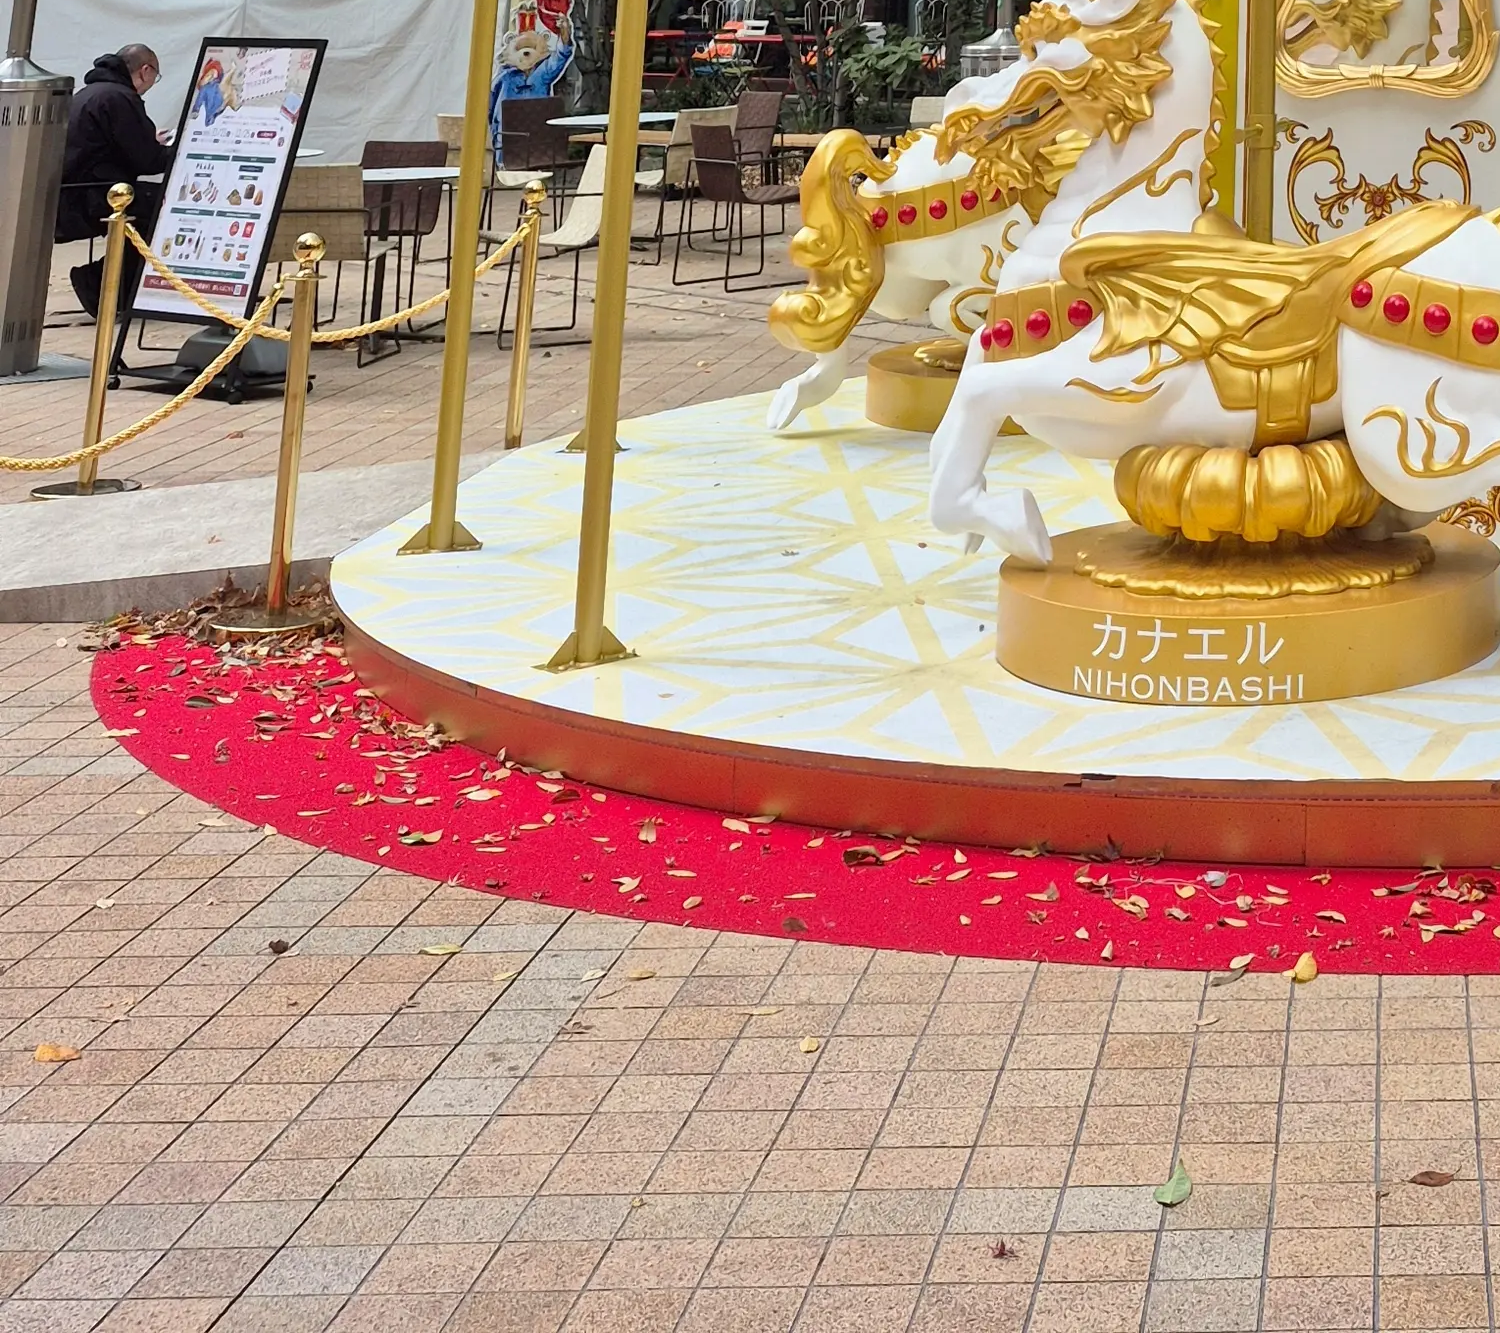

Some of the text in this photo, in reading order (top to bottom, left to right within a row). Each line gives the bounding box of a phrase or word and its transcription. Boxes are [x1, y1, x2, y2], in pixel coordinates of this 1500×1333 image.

[1091, 613, 1285, 665] カナエル
[1072, 665, 1305, 703] NIHONBASHI
